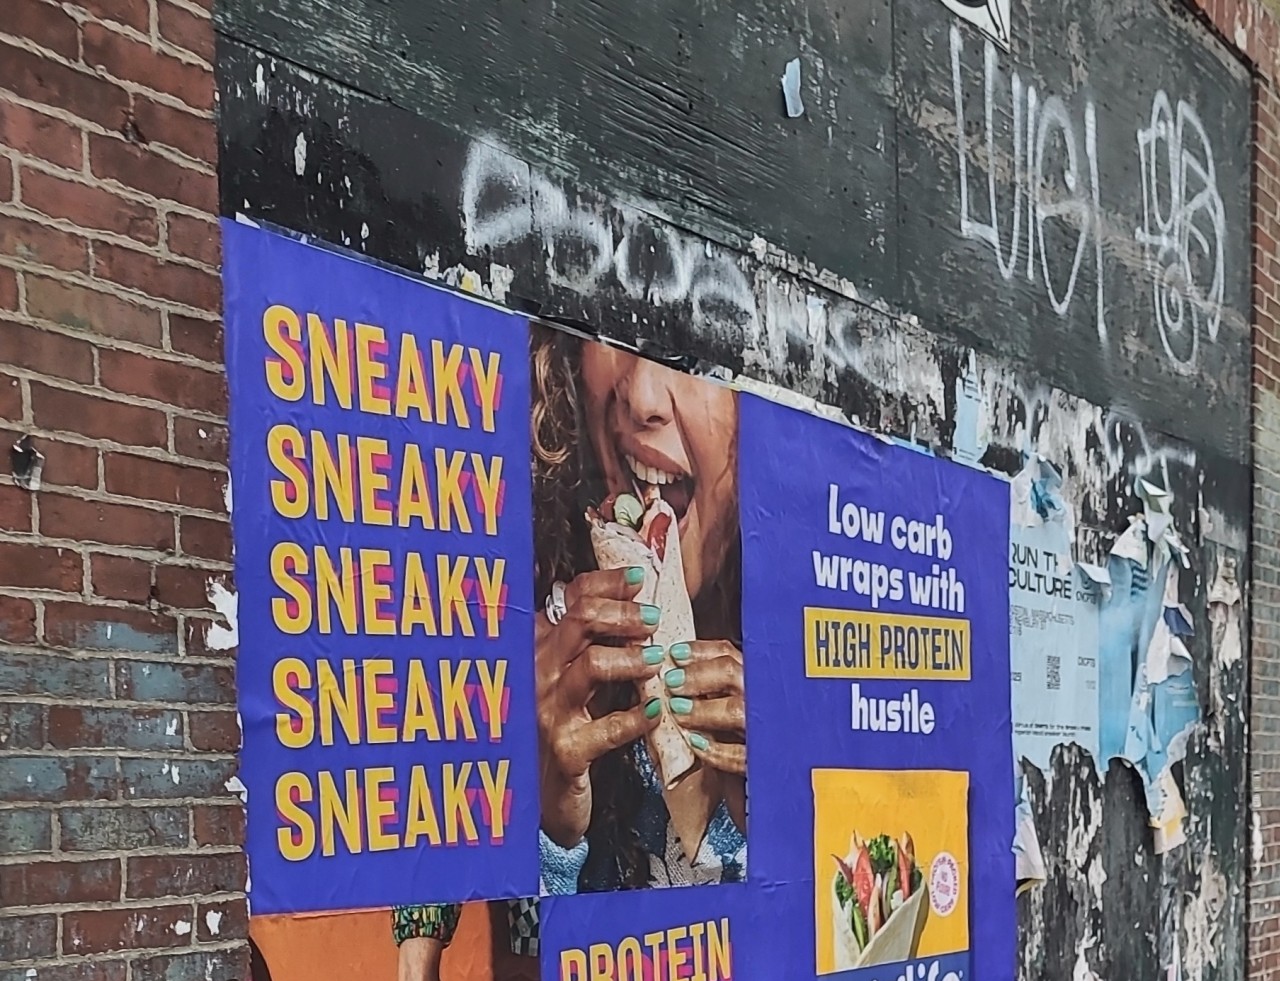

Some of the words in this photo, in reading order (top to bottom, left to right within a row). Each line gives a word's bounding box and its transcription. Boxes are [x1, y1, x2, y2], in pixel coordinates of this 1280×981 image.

[261, 304, 502, 433] SNEAKY
[267, 423, 504, 536] SNEAKY
[828, 483, 885, 545] Low
[890, 514, 953, 561] carb
[270, 542, 507, 640] SNEAKY
[812, 550, 904, 609] wraps
[907, 563, 965, 613] with
[1009, 566, 1072, 600] CULTURE
[815, 619, 871, 669] HIGH
[880, 624, 964, 672] PROTEIN
[272, 657, 509, 750] SNEAKY
[851, 682, 936, 735] hustle
[275, 759, 511, 861] SNEAKY
